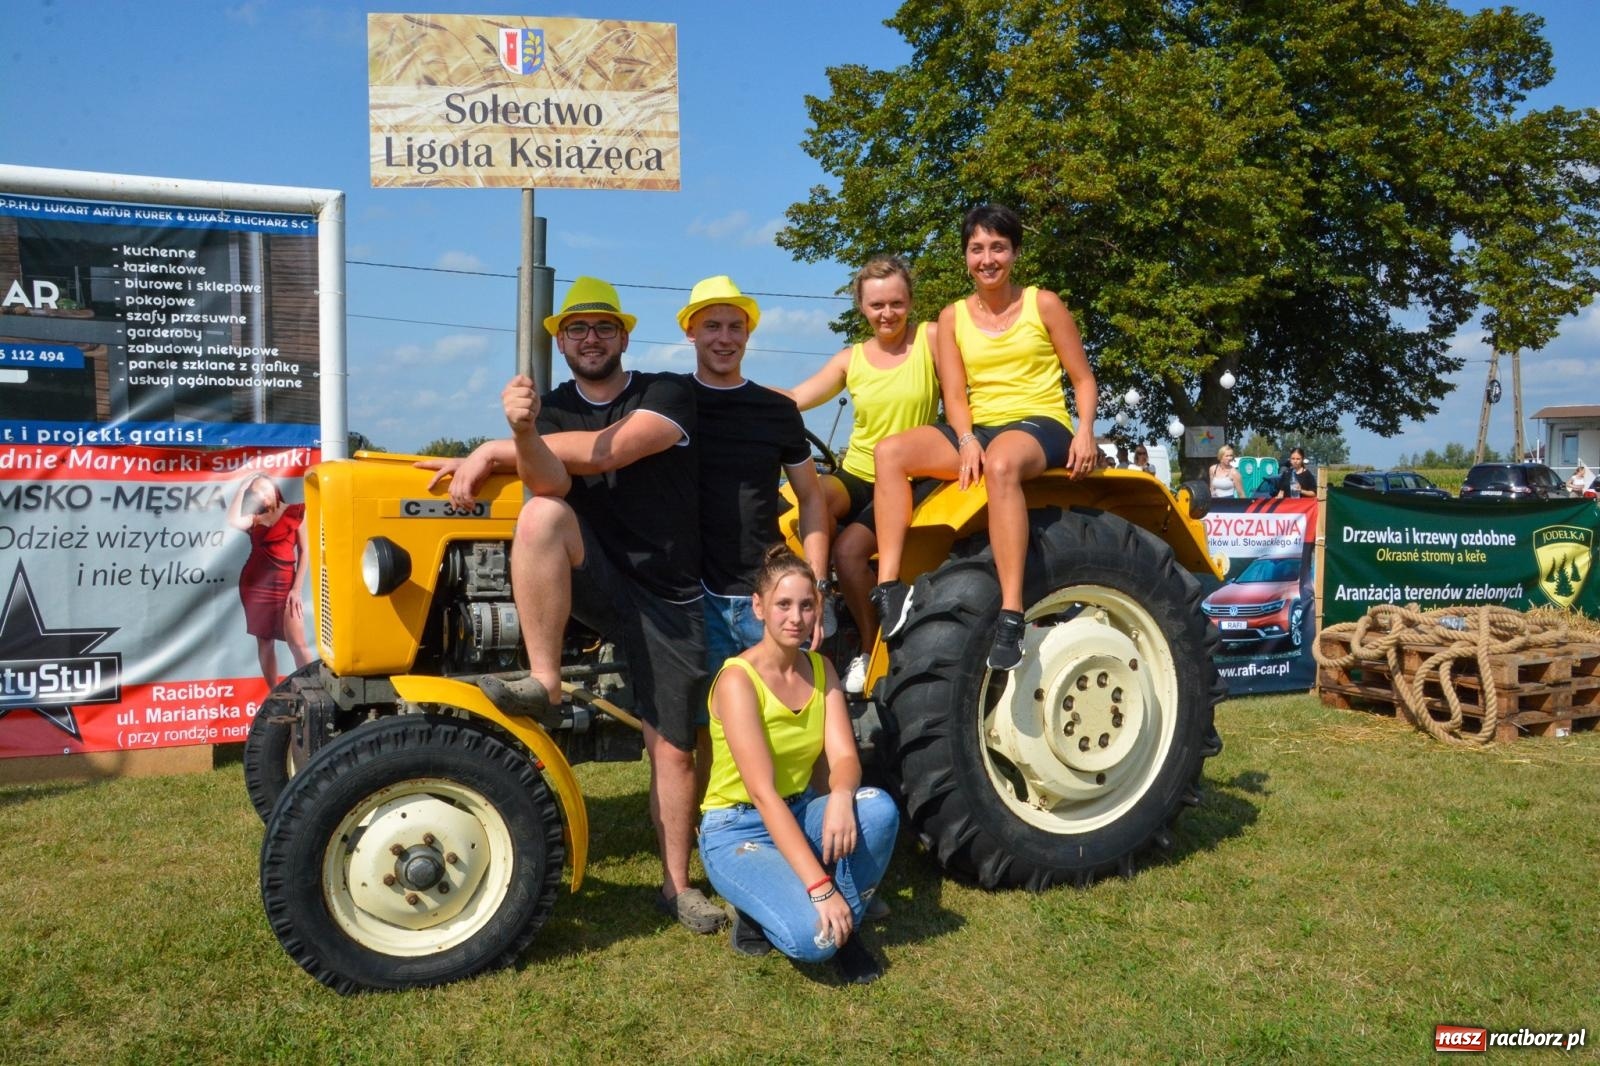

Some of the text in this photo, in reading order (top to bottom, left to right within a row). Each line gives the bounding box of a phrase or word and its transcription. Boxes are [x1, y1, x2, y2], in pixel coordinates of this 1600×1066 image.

[445, 92, 604, 126] Sołectwo
[385, 136, 665, 176] Ligota Książęca
[44, 203, 88, 216] LUKART
[93, 207, 131, 218] ARTUR
[135, 210, 172, 220] KUREK
[188, 213, 231, 224] ŁUKASZ
[234, 216, 288, 228] BLICHARZ
[123, 245, 196, 259] kuchenne
[123, 261, 206, 275] łazienkowe
[125, 277, 262, 294] biurowe i sklepowe
[126, 294, 196, 308] pokojowe
[126, 310, 247, 326] szafy przesuwne
[127, 326, 202, 341] garderoby
[11, 350, 35, 360] 112
[39, 351, 64, 362] 494
[128, 343, 279, 359] zabudowy nietypowe
[129, 359, 299, 375] panele szklane z grafiką
[129, 375, 302, 389] usługi ogólnobudowlane
[21, 426, 27, 440] i
[37, 427, 120, 446] projekt
[130, 427, 203, 444] gratis!
[69, 449, 201, 474] Marynarki
[405, 501, 420, 516] C
[0, 525, 224, 551] Odzież wizytowa
[1208, 538, 1228, 546] ików
[1243, 538, 1291, 548] Słowackiego
[1343, 526, 1516, 548] Drzewka i krzewy ozdobne
[1542, 530, 1585, 543] JODEŁKA
[1376, 548, 1419, 562] Okrasné
[1422, 550, 1454, 564] stromy
[1457, 552, 1462, 561] a
[78, 563, 84, 586] i
[92, 565, 132, 586] nie
[1335, 584, 1523, 604] Aranżacja terenów zielonych
[152, 682, 234, 700] Racibórz
[117, 710, 139, 725] ul.
[146, 703, 240, 723] Mariańska
[128, 732, 159, 746] przy
[164, 725, 218, 741] rondzie
